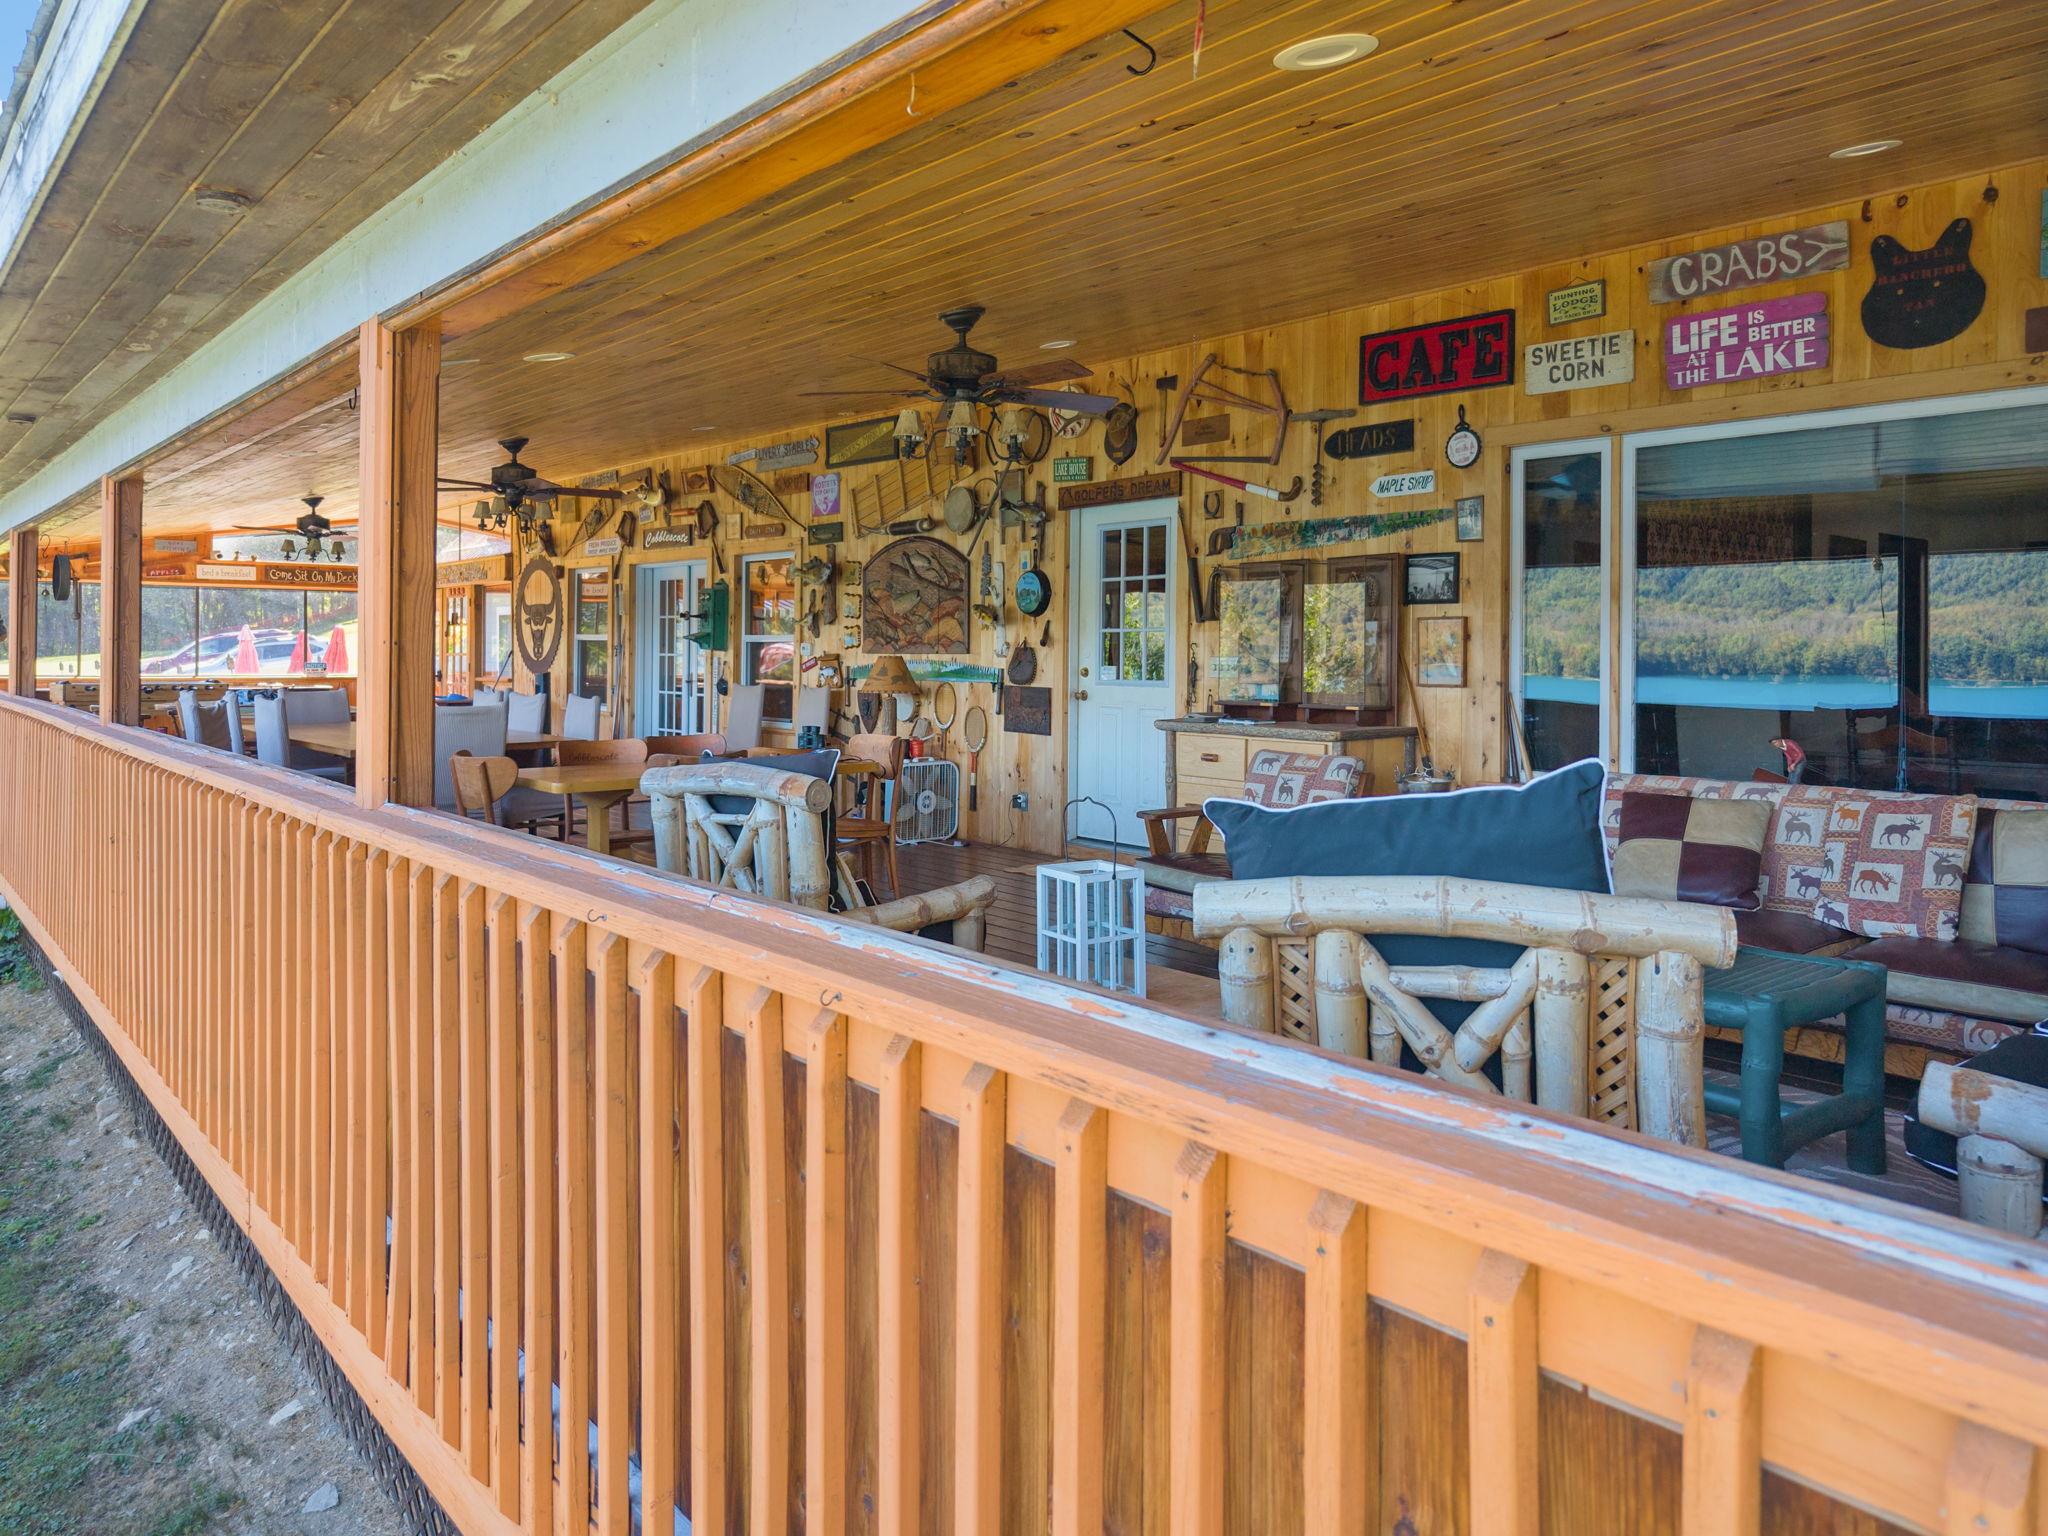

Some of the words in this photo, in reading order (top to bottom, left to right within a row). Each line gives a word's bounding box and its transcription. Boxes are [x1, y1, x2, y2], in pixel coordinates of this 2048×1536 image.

[1671, 234, 1802, 296] CRABS
[1552, 294, 1599, 312] LODGE
[1554, 287, 1595, 302] HUNTING
[1672, 313, 1739, 355] LIFE
[1747, 309, 1765, 325] IS
[1748, 317, 1816, 343] BETTER
[1367, 322, 1504, 392] CAFE
[1531, 334, 1621, 366] SWEETIE
[1686, 350, 1710, 368] AT
[1674, 367, 1711, 385] THE
[1715, 336, 1817, 380] LAKE
[1549, 358, 1605, 384] CORN
[784, 438, 815, 456] STABLES
[1337, 426, 1396, 454] HEADS
[1055, 463, 1068, 476] LAKE
[1069, 463, 1087, 475] HOUSE
[1130, 478, 1171, 496] DREAM
[1376, 477, 1405, 494] MAPLE
[1408, 474, 1434, 491] SYRUP
[645, 531, 690, 548] Cobblescote
[150, 568, 181, 577] APPLES
[201, 567, 214, 577] bed
[269, 569, 293, 580] Come
[293, 569, 308, 581] Sit
[311, 571, 324, 583] On
[325, 572, 336, 583] My
[336, 571, 358, 583] Deck
